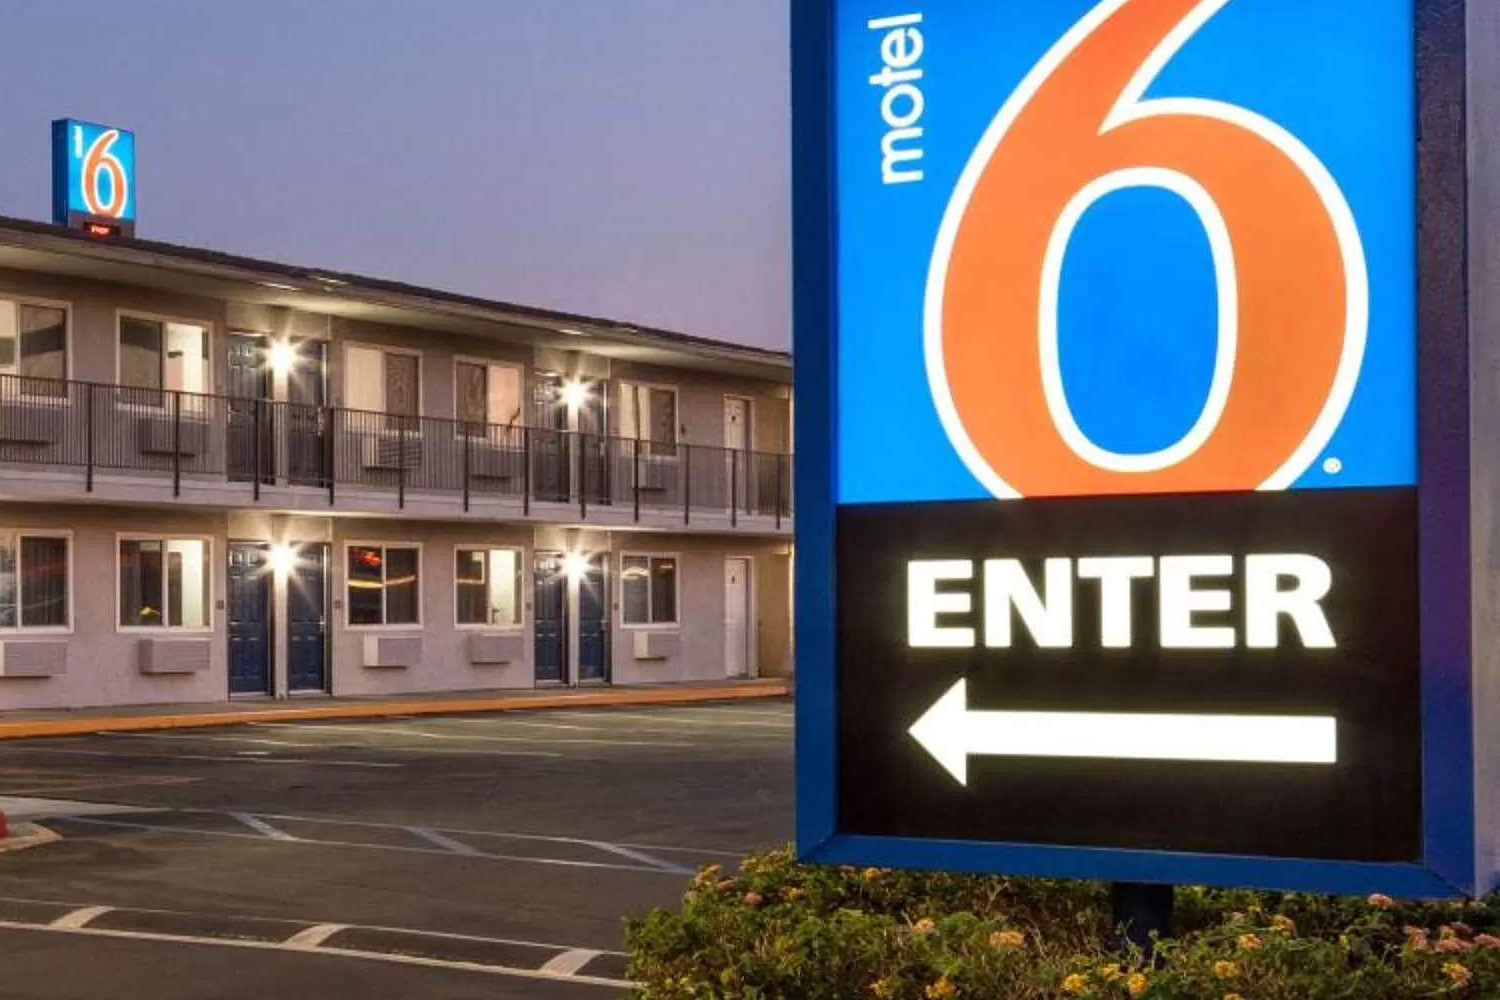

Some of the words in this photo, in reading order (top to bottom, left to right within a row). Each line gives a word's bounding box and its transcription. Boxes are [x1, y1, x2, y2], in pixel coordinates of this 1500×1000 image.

[868, 12, 924, 185] motel
[82, 129, 128, 218] 6
[906, 553, 1337, 648] ENTER
